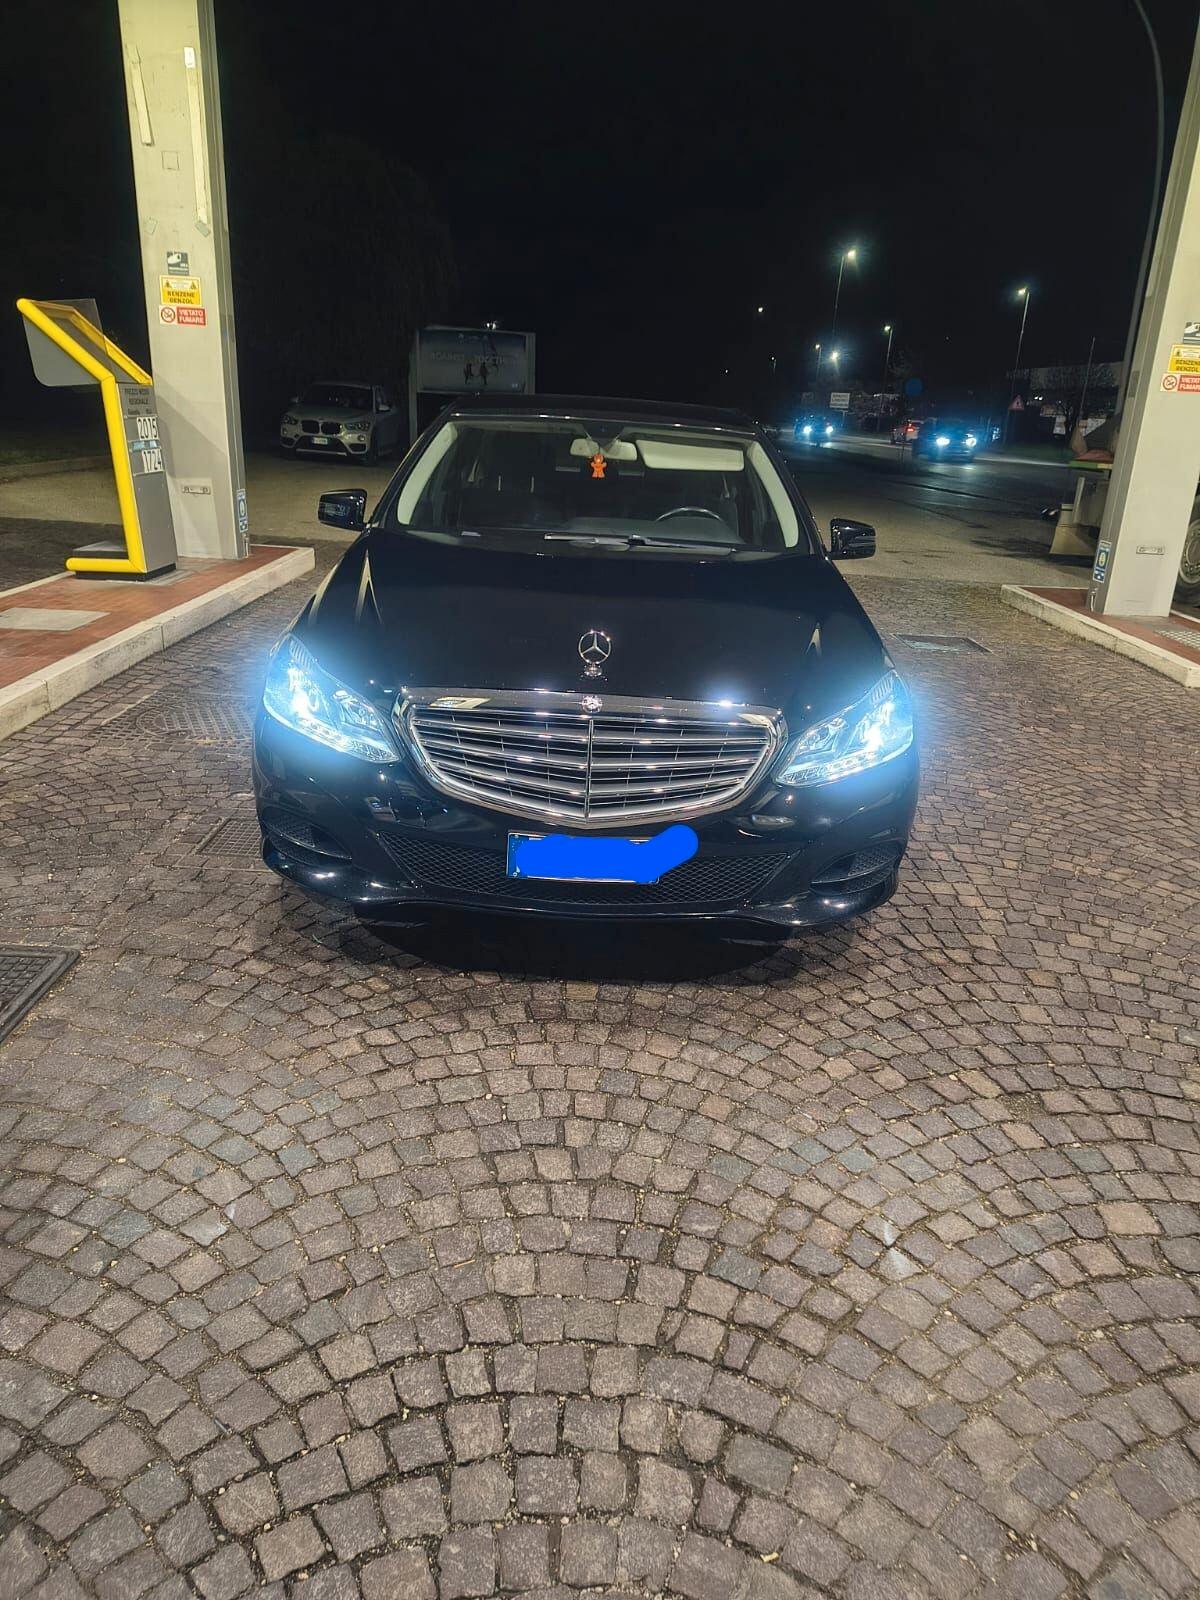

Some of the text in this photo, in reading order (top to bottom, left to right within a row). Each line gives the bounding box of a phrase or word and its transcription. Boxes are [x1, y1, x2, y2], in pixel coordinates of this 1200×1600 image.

[167, 290, 195, 298] BENZENE
[179, 309, 204, 317] VIETATO
[179, 315, 204, 324] FUMARE
[137, 417, 158, 439] 2015
[143, 449, 162, 472] 1724
